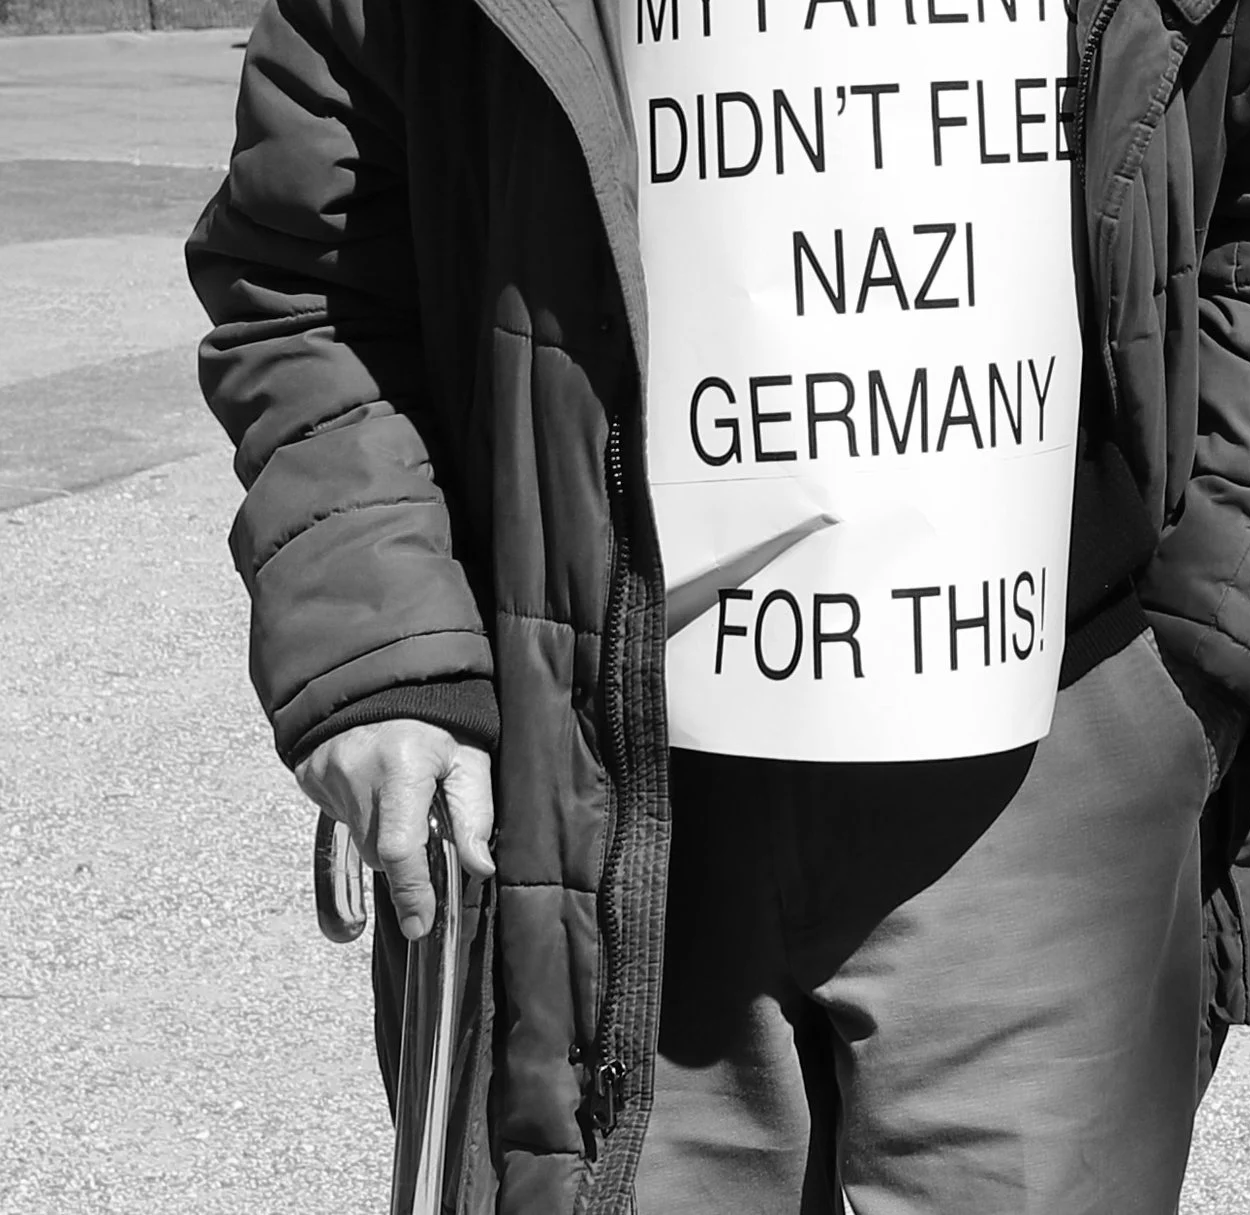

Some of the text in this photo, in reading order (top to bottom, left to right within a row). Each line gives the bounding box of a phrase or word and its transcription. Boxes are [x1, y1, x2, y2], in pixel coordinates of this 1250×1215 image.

[930, 77, 1082, 167] FLEE
[792, 221, 976, 317] NAZI
[689, 355, 1056, 467] GERMANY
[714, 566, 1047, 680] FOR THIS!
